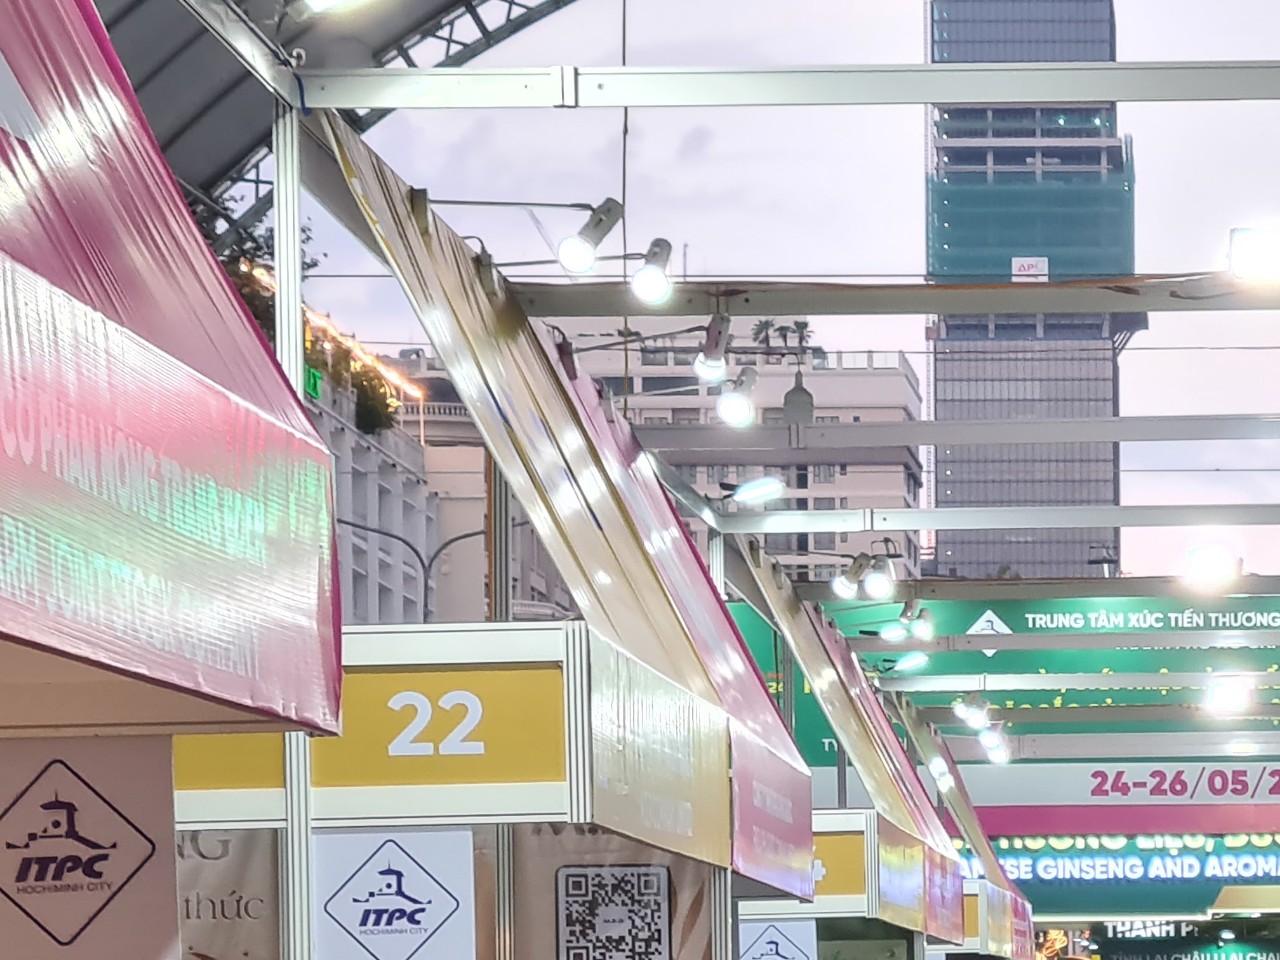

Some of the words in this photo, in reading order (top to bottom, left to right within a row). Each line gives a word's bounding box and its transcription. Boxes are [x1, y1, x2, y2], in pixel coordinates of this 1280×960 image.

[1025, 612, 1085, 629] TRUNG
[1088, 609, 1124, 628] TÂM
[1128, 609, 1165, 628] XÚC
[1168, 608, 1204, 628] TIẾN
[387, 691, 485, 756] 22
[15, 853, 109, 883] ITPC
[1036, 857, 1144, 880] GINSENG
[1148, 856, 1200, 879] AND
[87, 882, 112, 892] CITY
[184, 890, 264, 920] thức
[358, 907, 427, 927] ITPC
[409, 927, 429, 935] CITY
